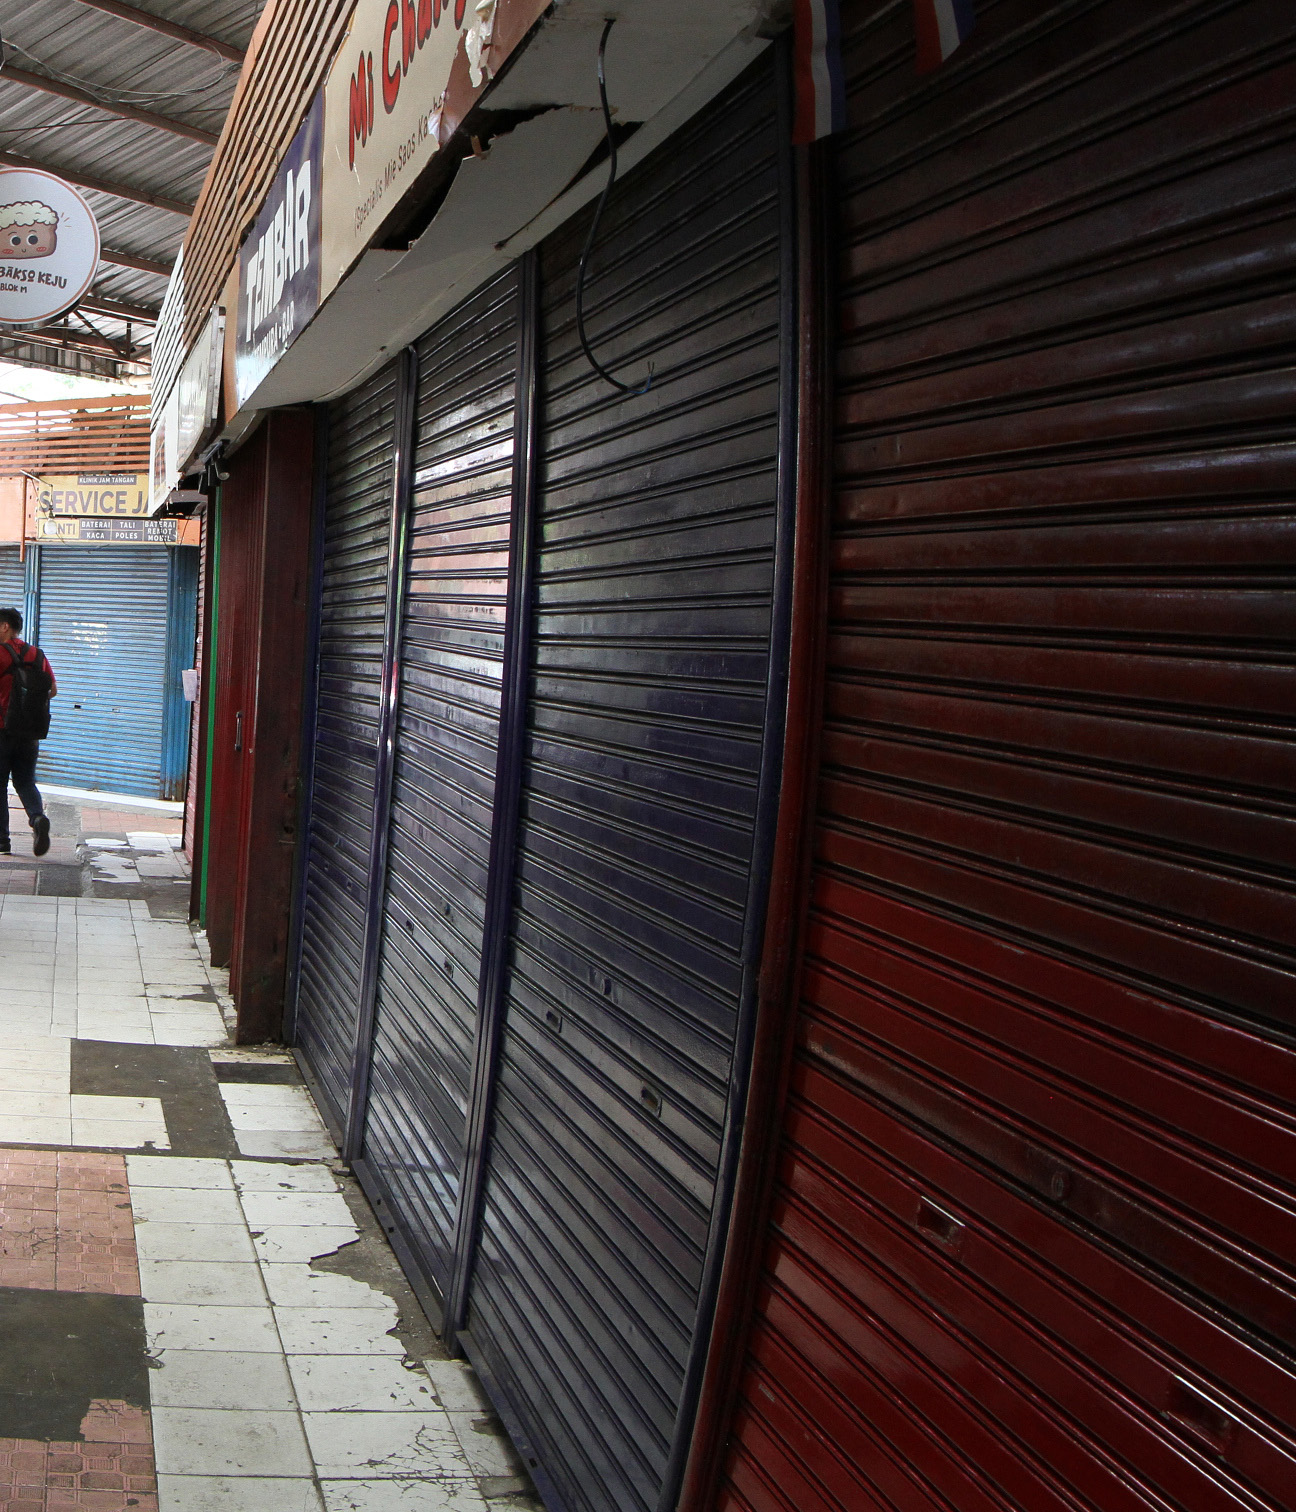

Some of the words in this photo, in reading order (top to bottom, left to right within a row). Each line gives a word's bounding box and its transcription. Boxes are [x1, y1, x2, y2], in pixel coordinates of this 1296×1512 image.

[349, 50, 374, 171] Mi
[384, 159, 396, 191] Mie
[398, 132, 416, 172] Saos
[245, 160, 311, 343] TEMBAR
[0, 283, 18, 292] BLOK
[37, 271, 68, 289] KEJU
[39, 490, 128, 514] SERVICE
[43, 523, 76, 535] NTI
[120, 521, 136, 529] TALI
